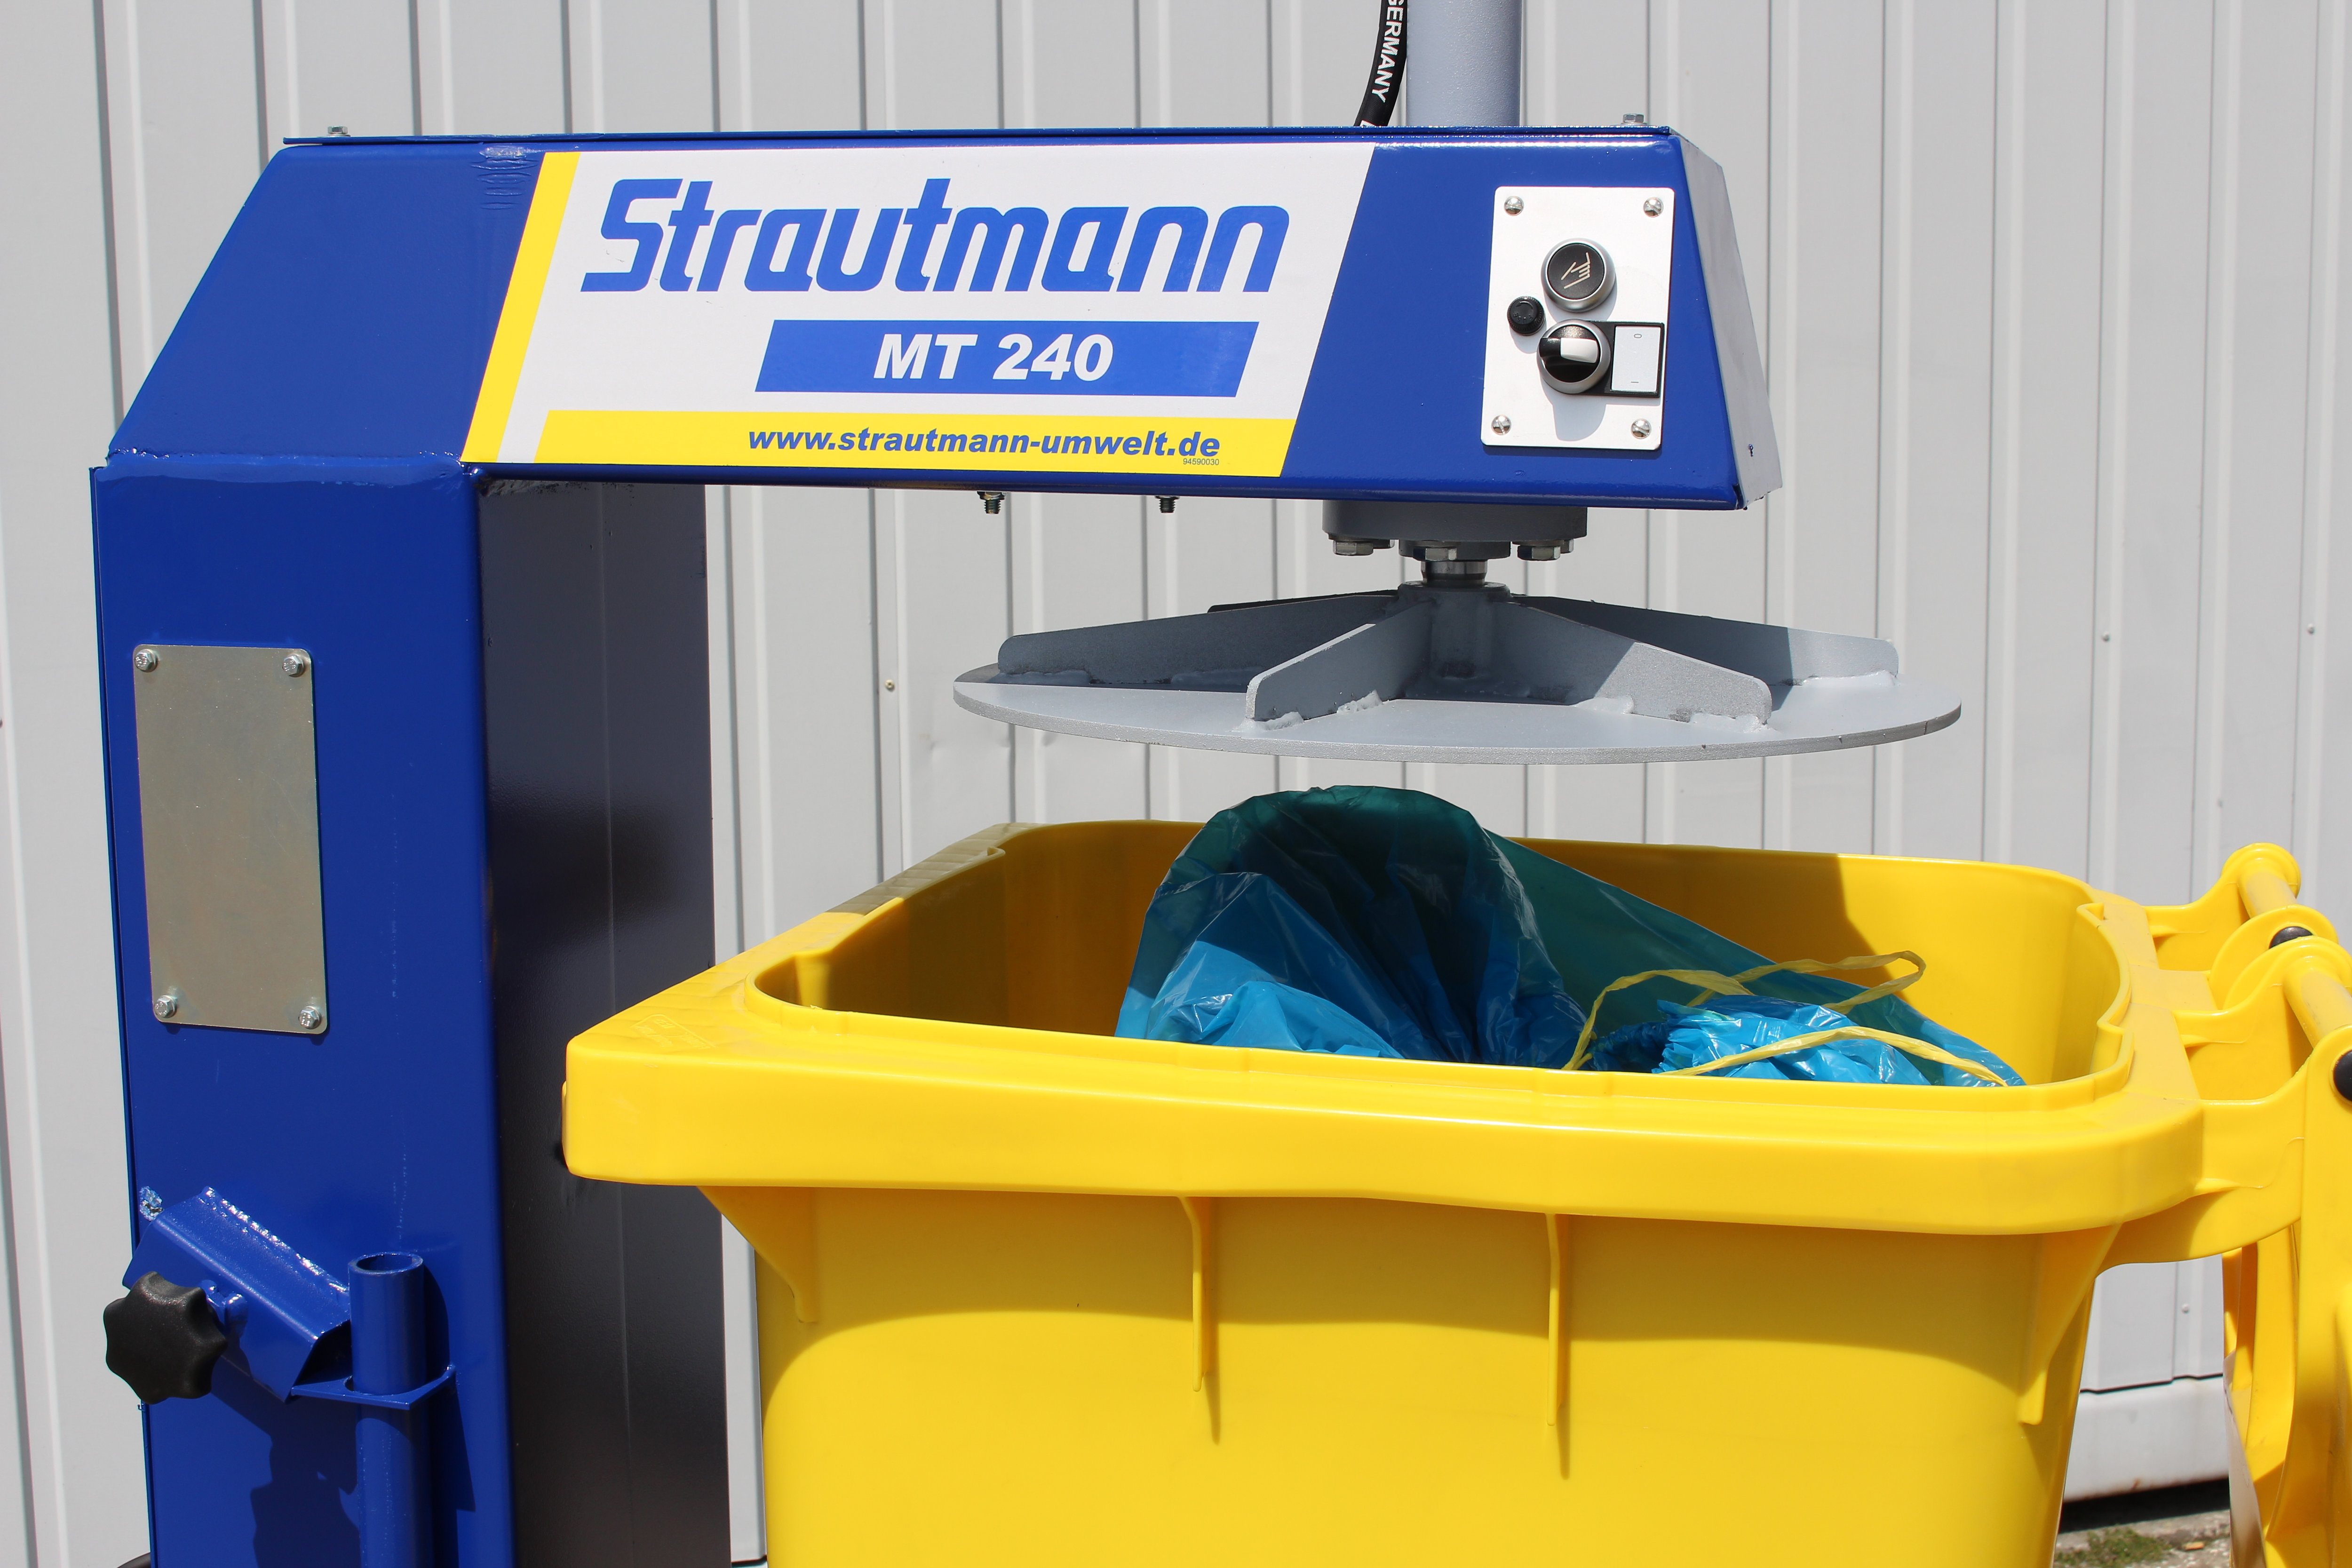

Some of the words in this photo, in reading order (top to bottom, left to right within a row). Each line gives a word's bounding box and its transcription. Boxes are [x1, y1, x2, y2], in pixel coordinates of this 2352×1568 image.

[580, 178, 1289, 292] Strautmann
[874, 334, 978, 379] MT
[993, 333, 1113, 381] 240
[749, 427, 1220, 457] www.strautmann-umwelt.de
